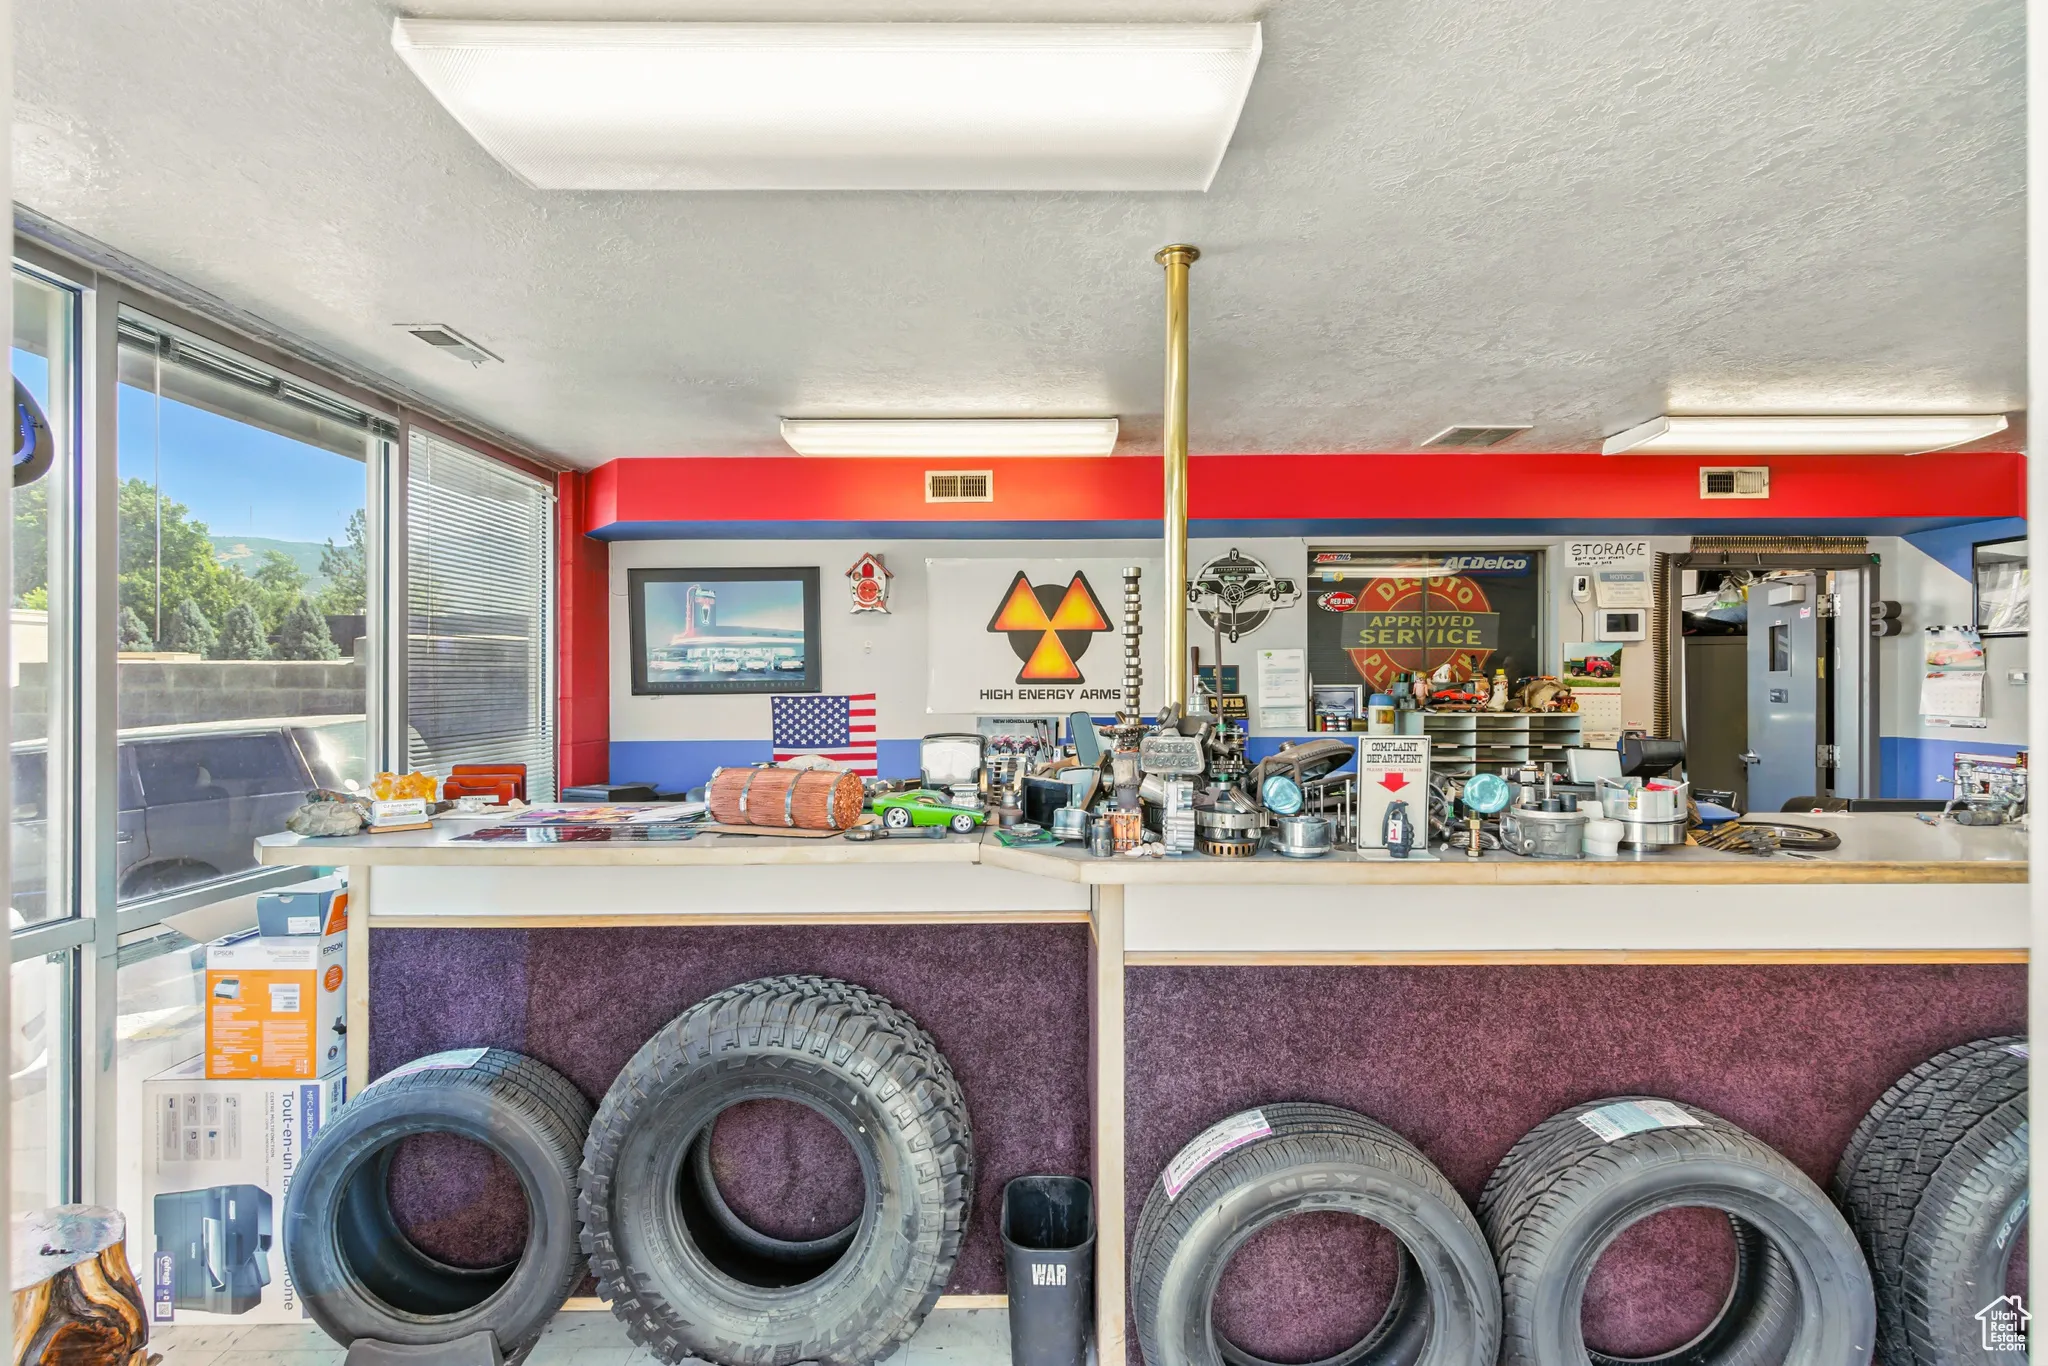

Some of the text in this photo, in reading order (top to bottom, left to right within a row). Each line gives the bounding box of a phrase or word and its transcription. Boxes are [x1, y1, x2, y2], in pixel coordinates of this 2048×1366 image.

[1231, 550, 1237, 560] 12
[1571, 543, 1645, 555] STORAGE
[1314, 552, 1351, 563] AMSOIL
[1443, 556, 1527, 570] ACDelco
[1370, 616, 1475, 627] APPROVED
[1359, 629, 1482, 645] SERVICE
[1363, 653, 1472, 690] PLYTH
[980, 689, 1121, 700] HIGH ENERGY ARMS
[1210, 698, 1244, 708] NFIB
[1371, 742, 1419, 752] COMPLAINT
[1366, 754, 1423, 763] DEPARTMENT
[1390, 828, 1398, 840] 1
[323, 942, 344, 955] EPSON
[283, 1091, 294, 1170] Tout-en-un
[1269, 1173, 1423, 1210] NEXEN
[163, 1257, 171, 1286] refresh
[1032, 1264, 1067, 1285] WAR
